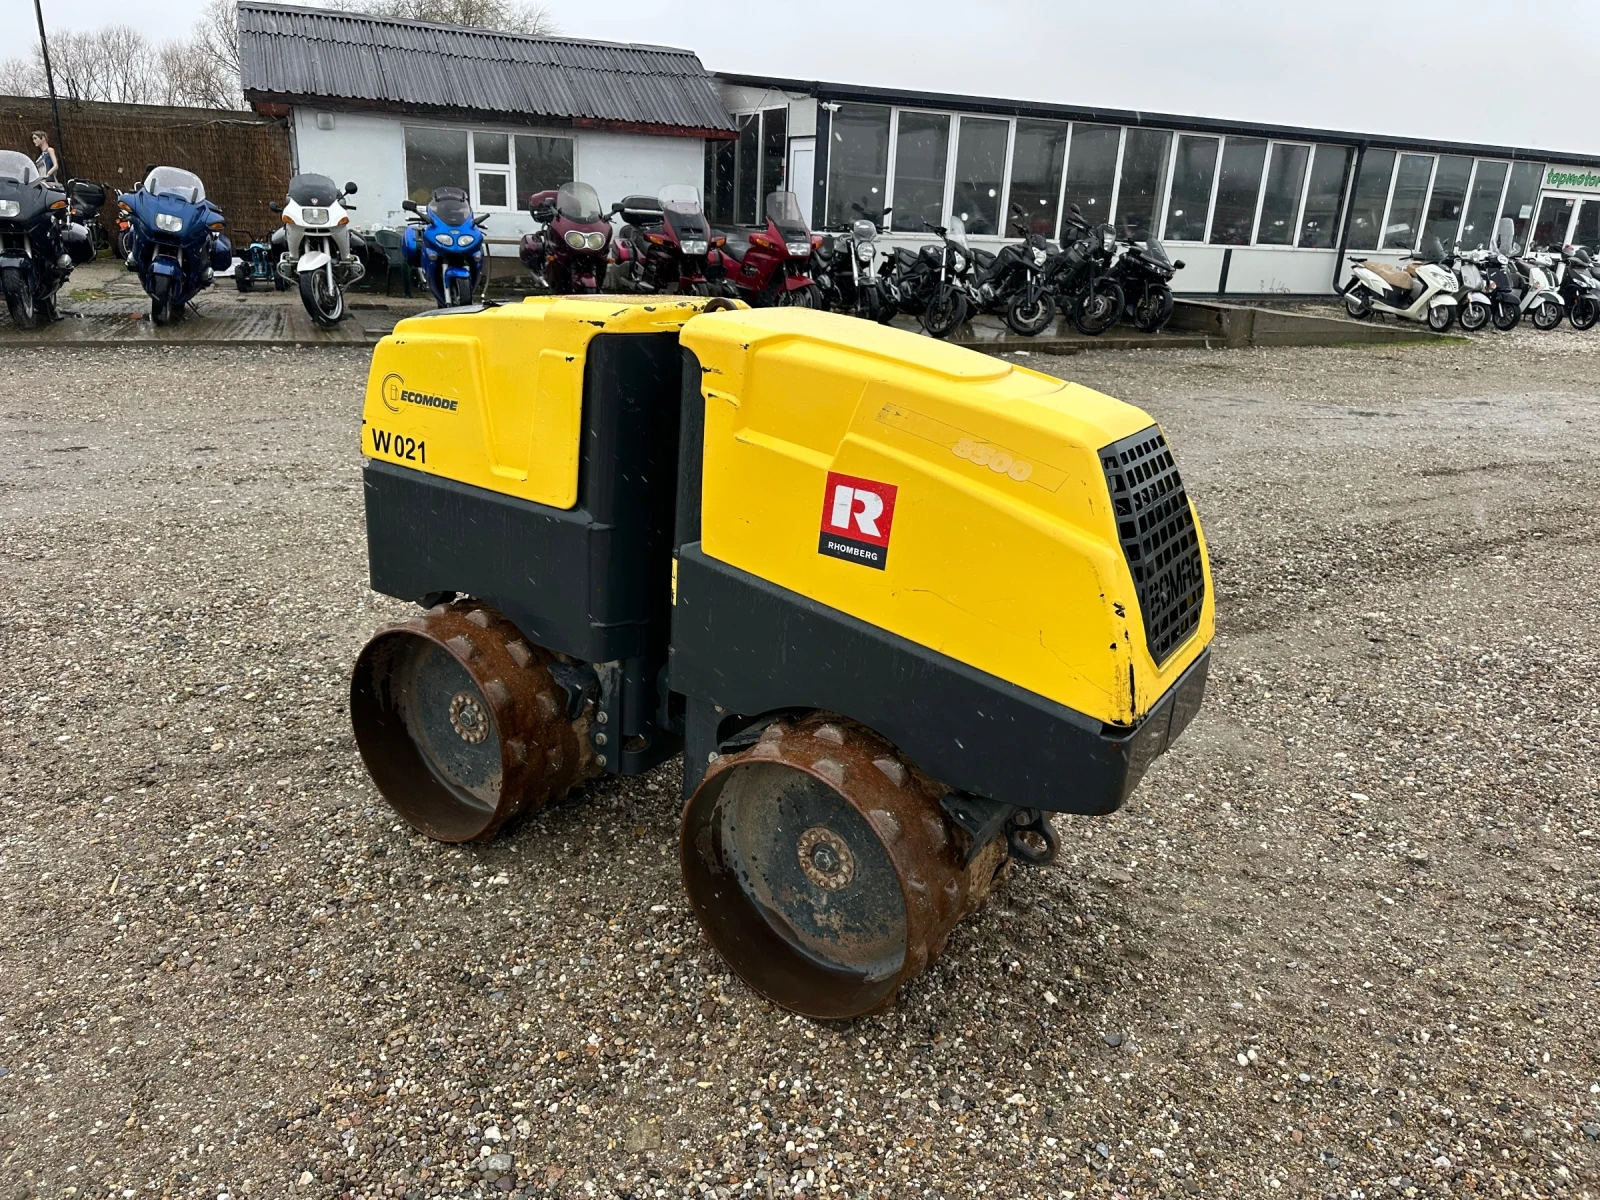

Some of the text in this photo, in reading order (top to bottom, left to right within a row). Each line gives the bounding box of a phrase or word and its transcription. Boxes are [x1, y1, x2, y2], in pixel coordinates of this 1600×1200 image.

[400, 390, 458, 411] ECOMODE
[951, 437, 1033, 482] 8500
[830, 484, 884, 537] R
[827, 541, 878, 561] RHOMBERG
